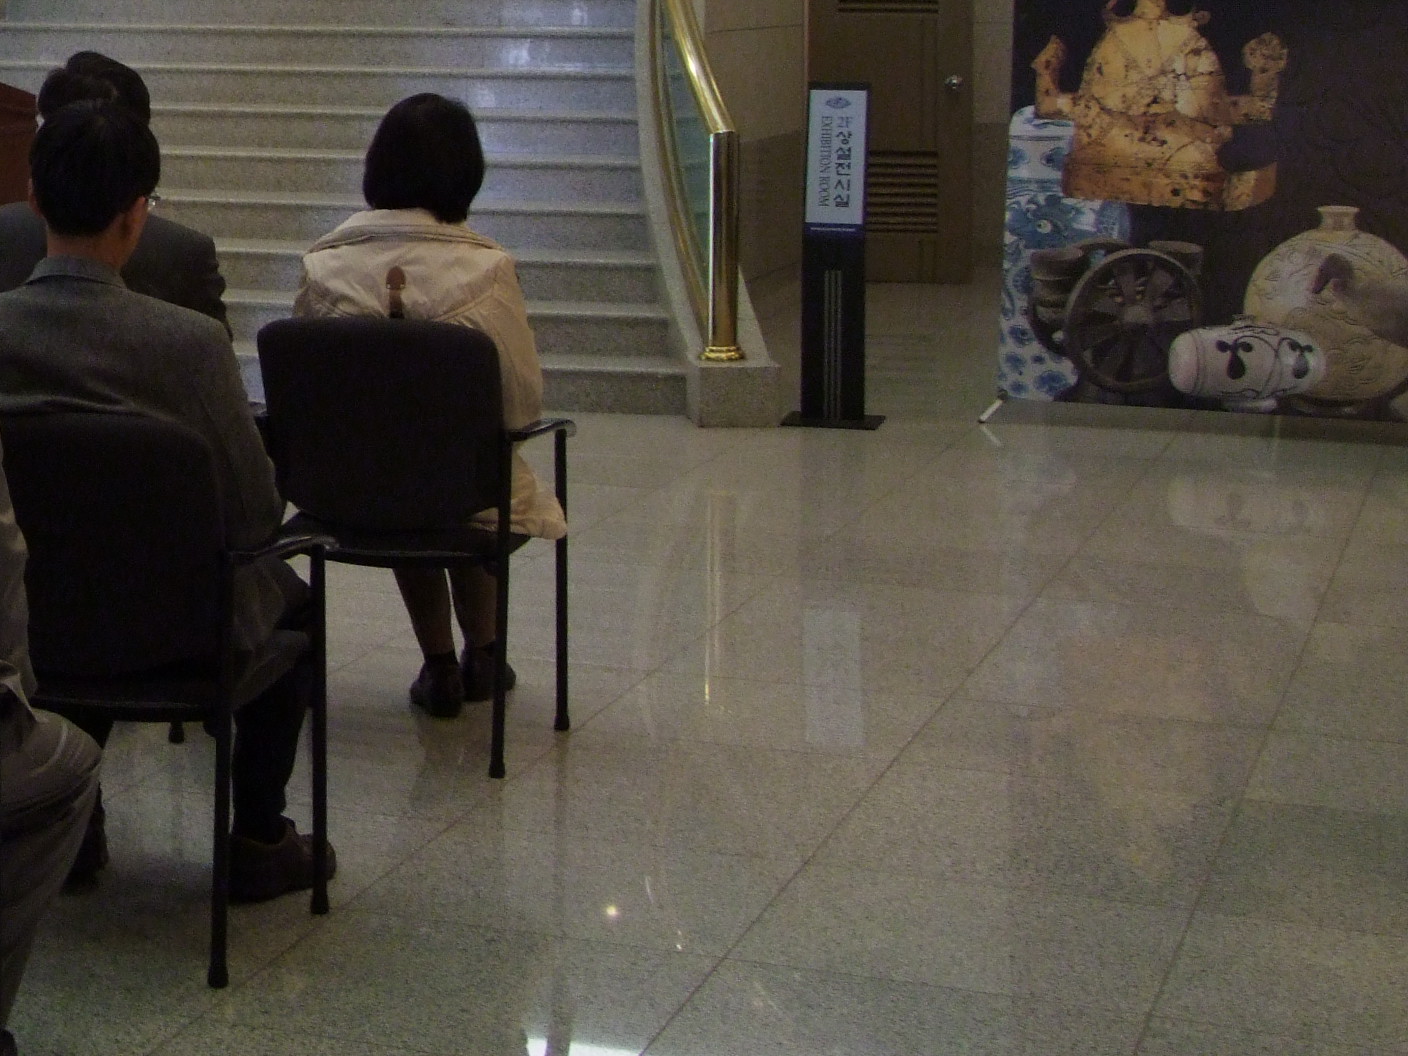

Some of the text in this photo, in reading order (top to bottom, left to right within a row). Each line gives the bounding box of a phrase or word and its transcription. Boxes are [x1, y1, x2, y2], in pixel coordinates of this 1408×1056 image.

[818, 115, 833, 207] EXHIBITION ROOM
[834, 130, 852, 208] 상설전시실
